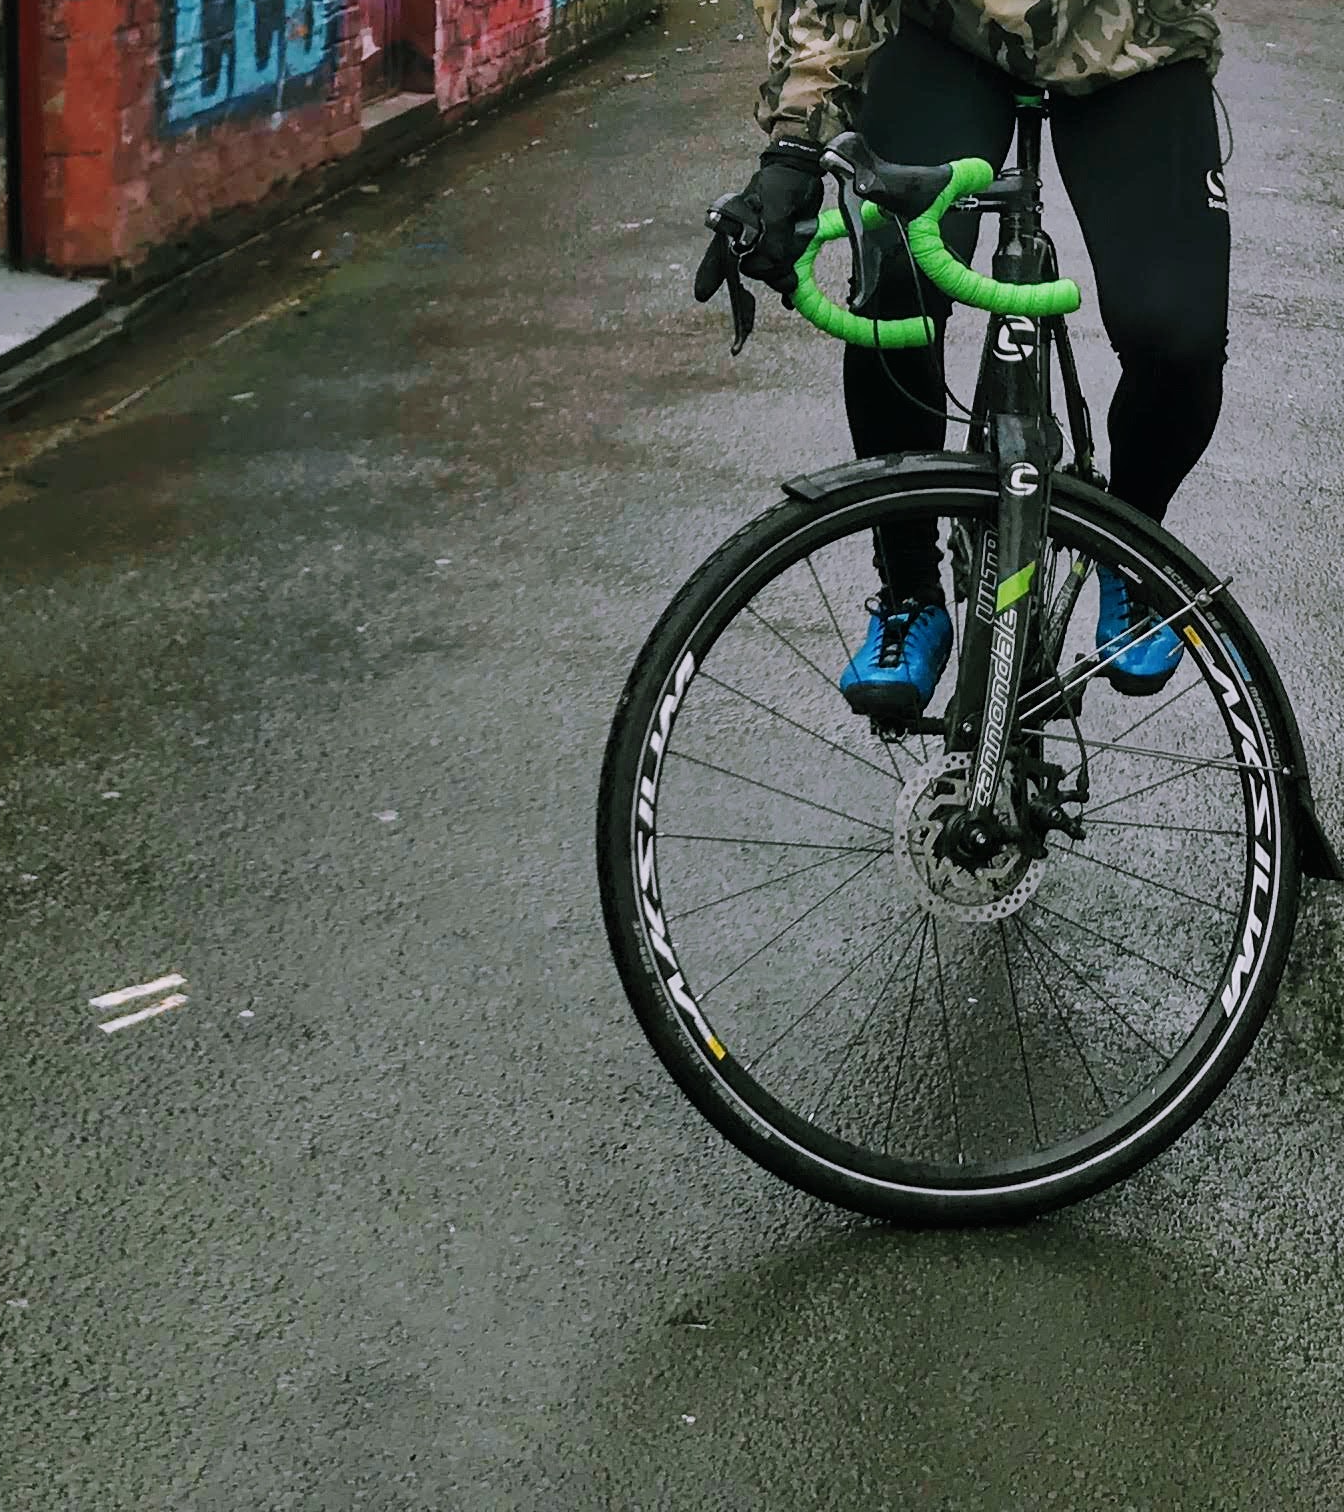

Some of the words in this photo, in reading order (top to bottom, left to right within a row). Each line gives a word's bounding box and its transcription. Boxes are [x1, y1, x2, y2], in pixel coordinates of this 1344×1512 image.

[972, 607, 1018, 808] cannondale
[1162, 564, 1223, 630] SCHWBE
[637, 650, 697, 1020] AKSIUM
[1208, 661, 1271, 1019] AKSIUM
